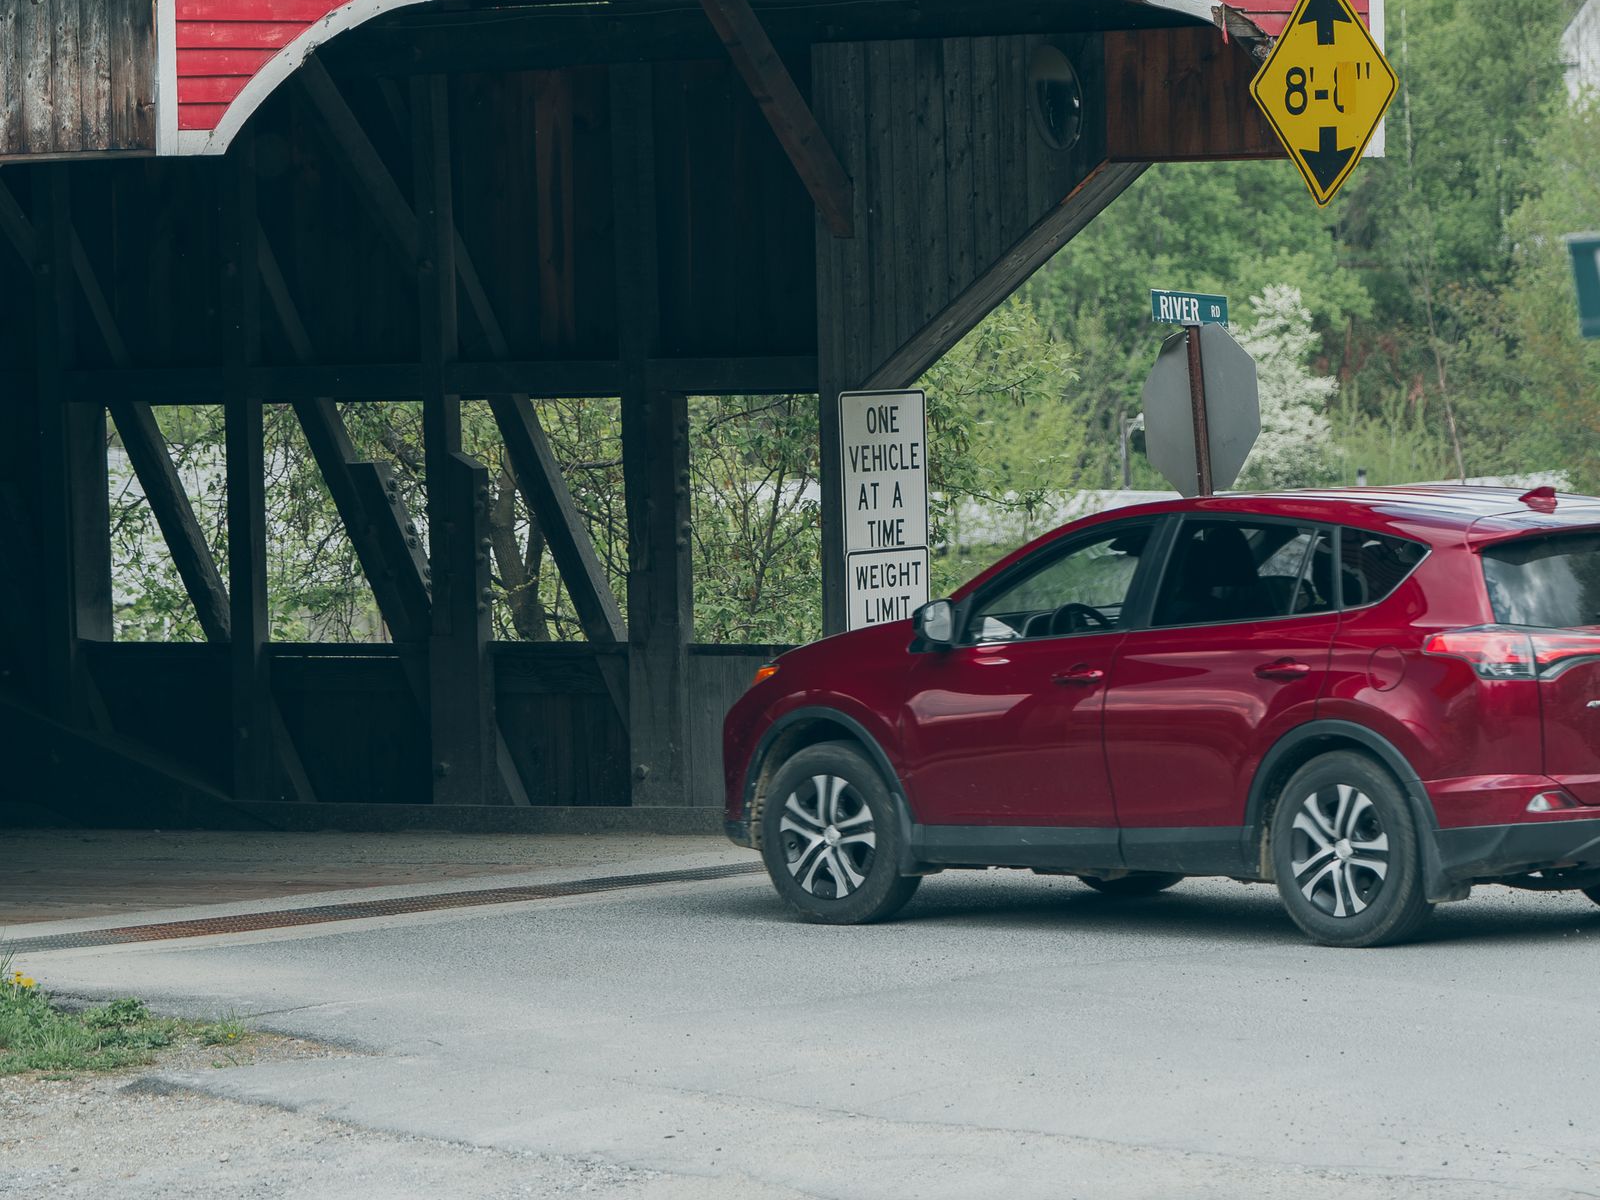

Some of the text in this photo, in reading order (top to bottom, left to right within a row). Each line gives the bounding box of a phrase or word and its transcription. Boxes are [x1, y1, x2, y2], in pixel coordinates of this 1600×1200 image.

[1159, 295, 1221, 322] RIVER RD
[866, 405, 900, 434] ONE
[849, 442, 920, 473] VEHICLE
[858, 481, 903, 511] AT A
[867, 518, 905, 548] TIME
[855, 561, 921, 591] WEIGHT
[865, 595, 911, 623] LIMIT
